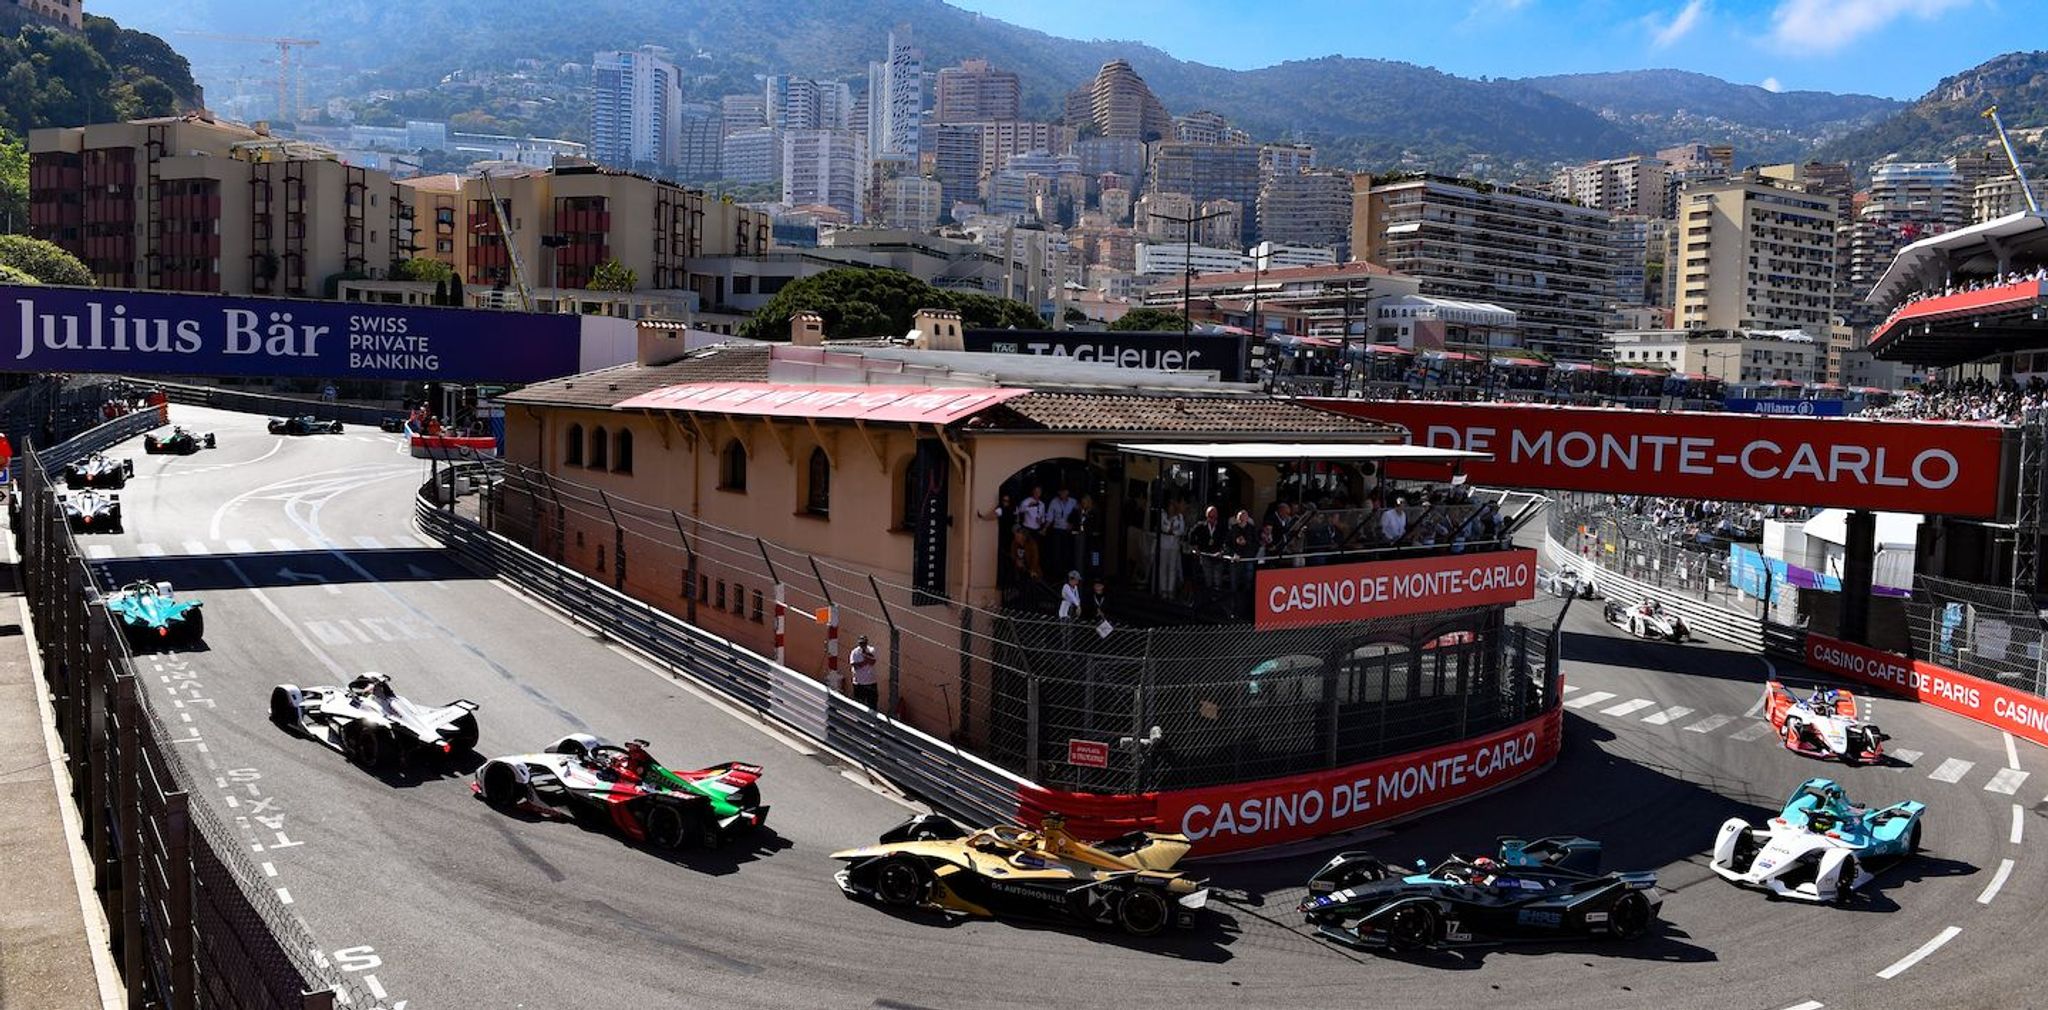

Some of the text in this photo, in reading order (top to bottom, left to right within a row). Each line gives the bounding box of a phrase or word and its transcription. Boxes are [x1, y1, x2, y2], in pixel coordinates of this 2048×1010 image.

[16, 299, 330, 360] Julius Bär
[350, 315, 408, 332] SWISS
[350, 334, 429, 352] PRIVATE
[350, 353, 440, 371] BANKING
[1755, 402, 1797, 414] Allianz
[1511, 429, 1959, 490] MONTE-CARLO
[1269, 563, 1528, 613] CASINO DE MONTE-CARLO
[1813, 644, 1865, 673] CASINO
[1867, 660, 1906, 685] CAFE
[1909, 672, 1929, 694] DE
[1933, 678, 1981, 708] PARIS
[1181, 731, 1536, 842] CASINO DE MONTE-CARLO
[1004, 885, 1067, 904] AUTOMOBILES
[1446, 920, 1460, 934] 17
